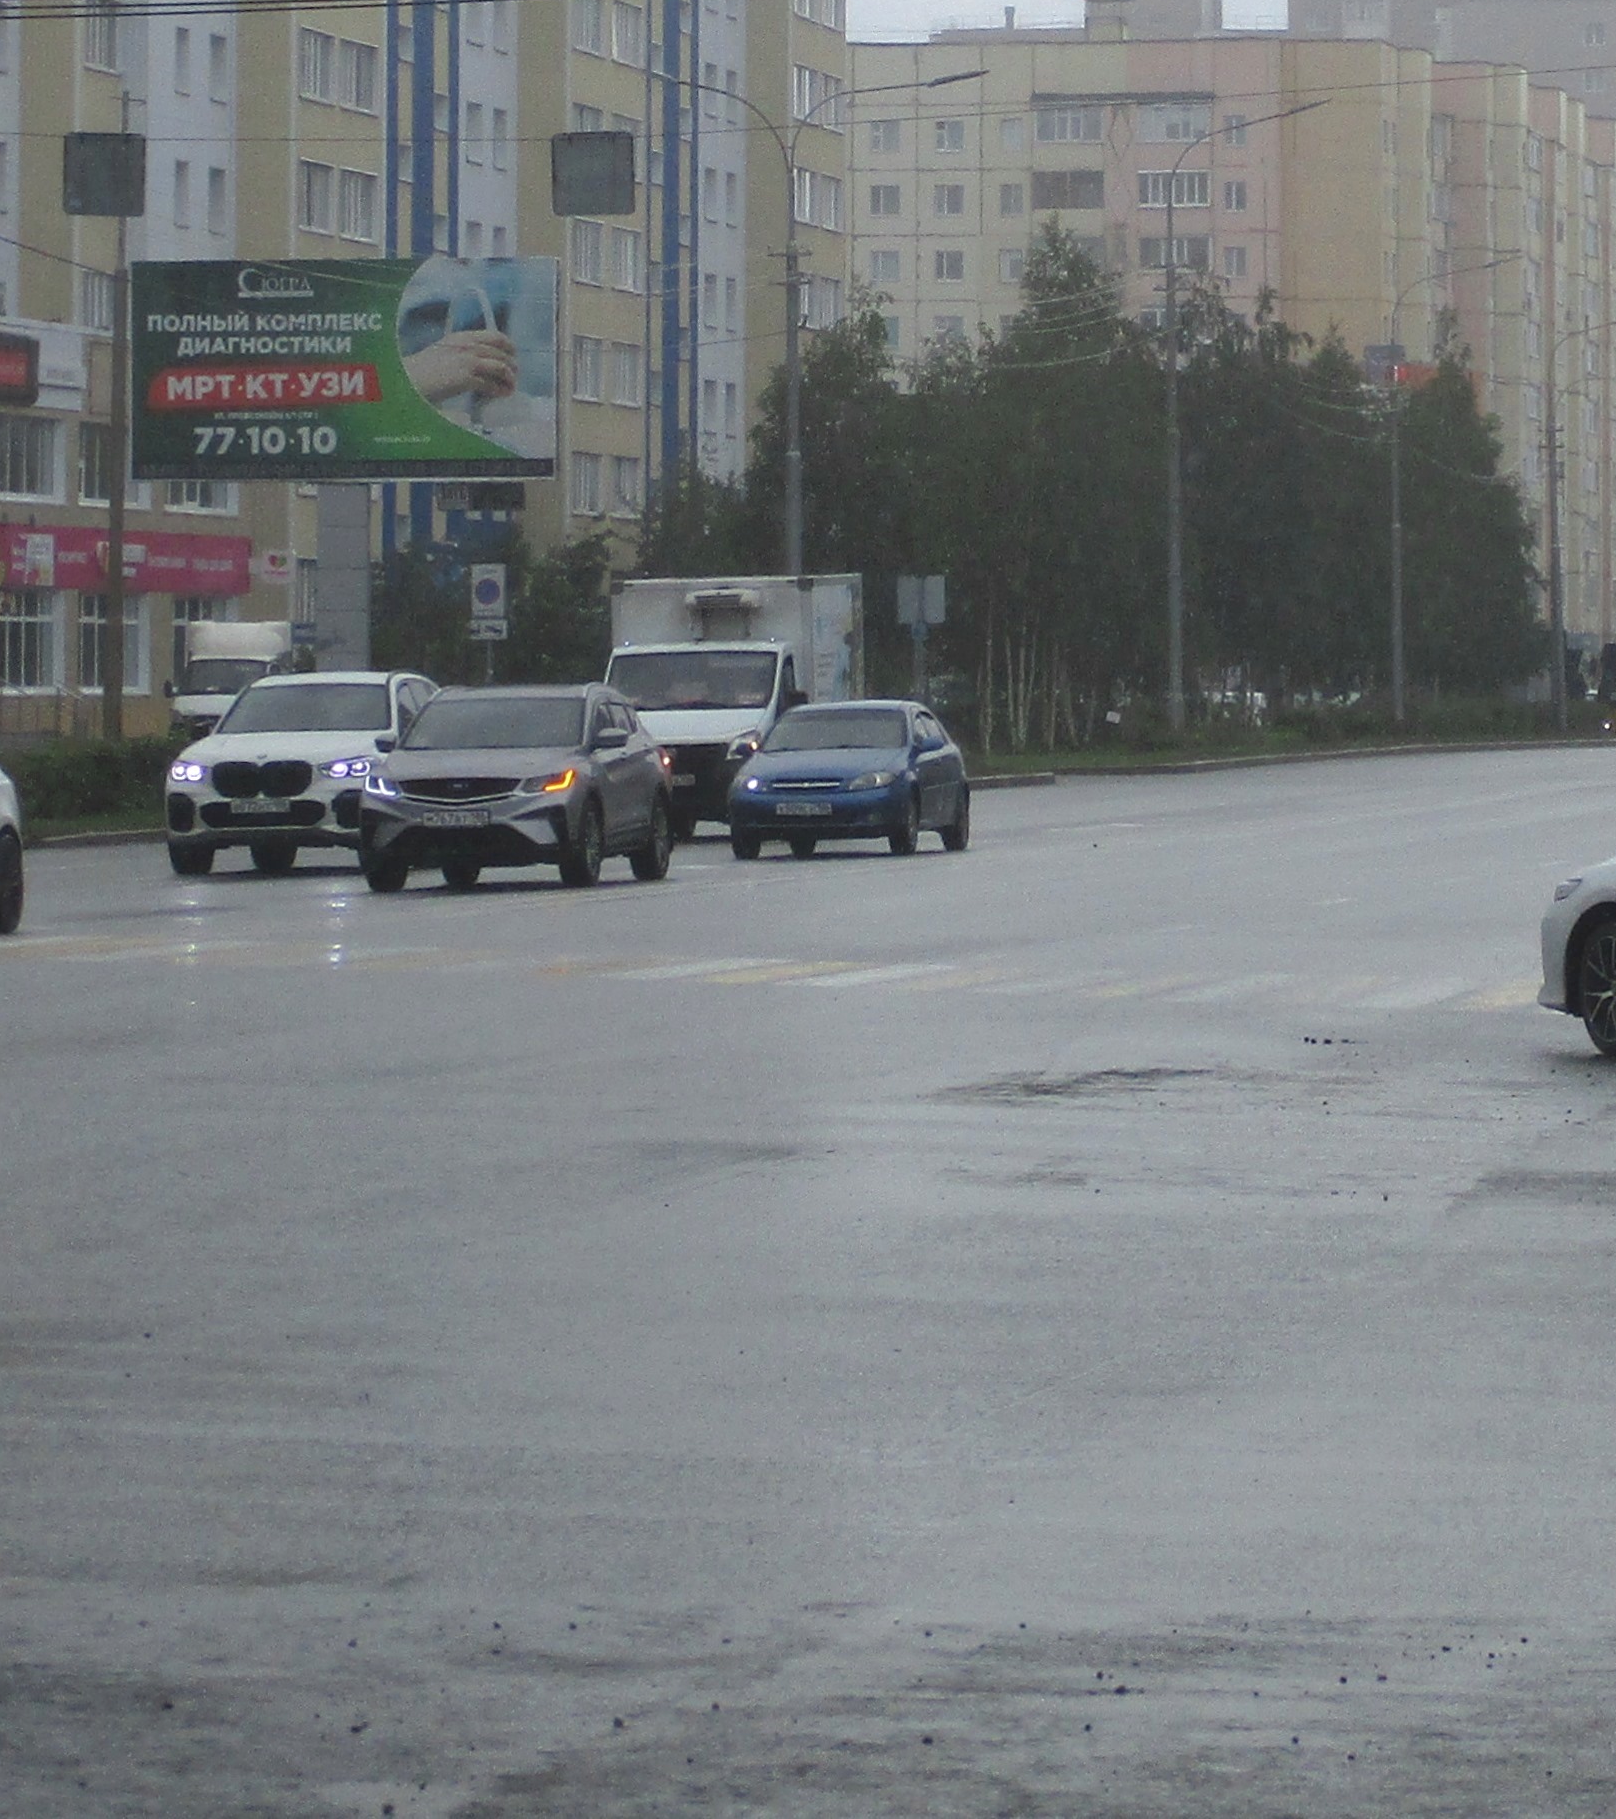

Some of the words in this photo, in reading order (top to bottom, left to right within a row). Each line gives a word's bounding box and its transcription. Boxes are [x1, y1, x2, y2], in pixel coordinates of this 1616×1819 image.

[147, 309, 250, 333] ПОЛНЫЙ
[255, 312, 383, 332] КОМПЛЕКС
[176, 335, 352, 357] ДИАГНОСТИКИ
